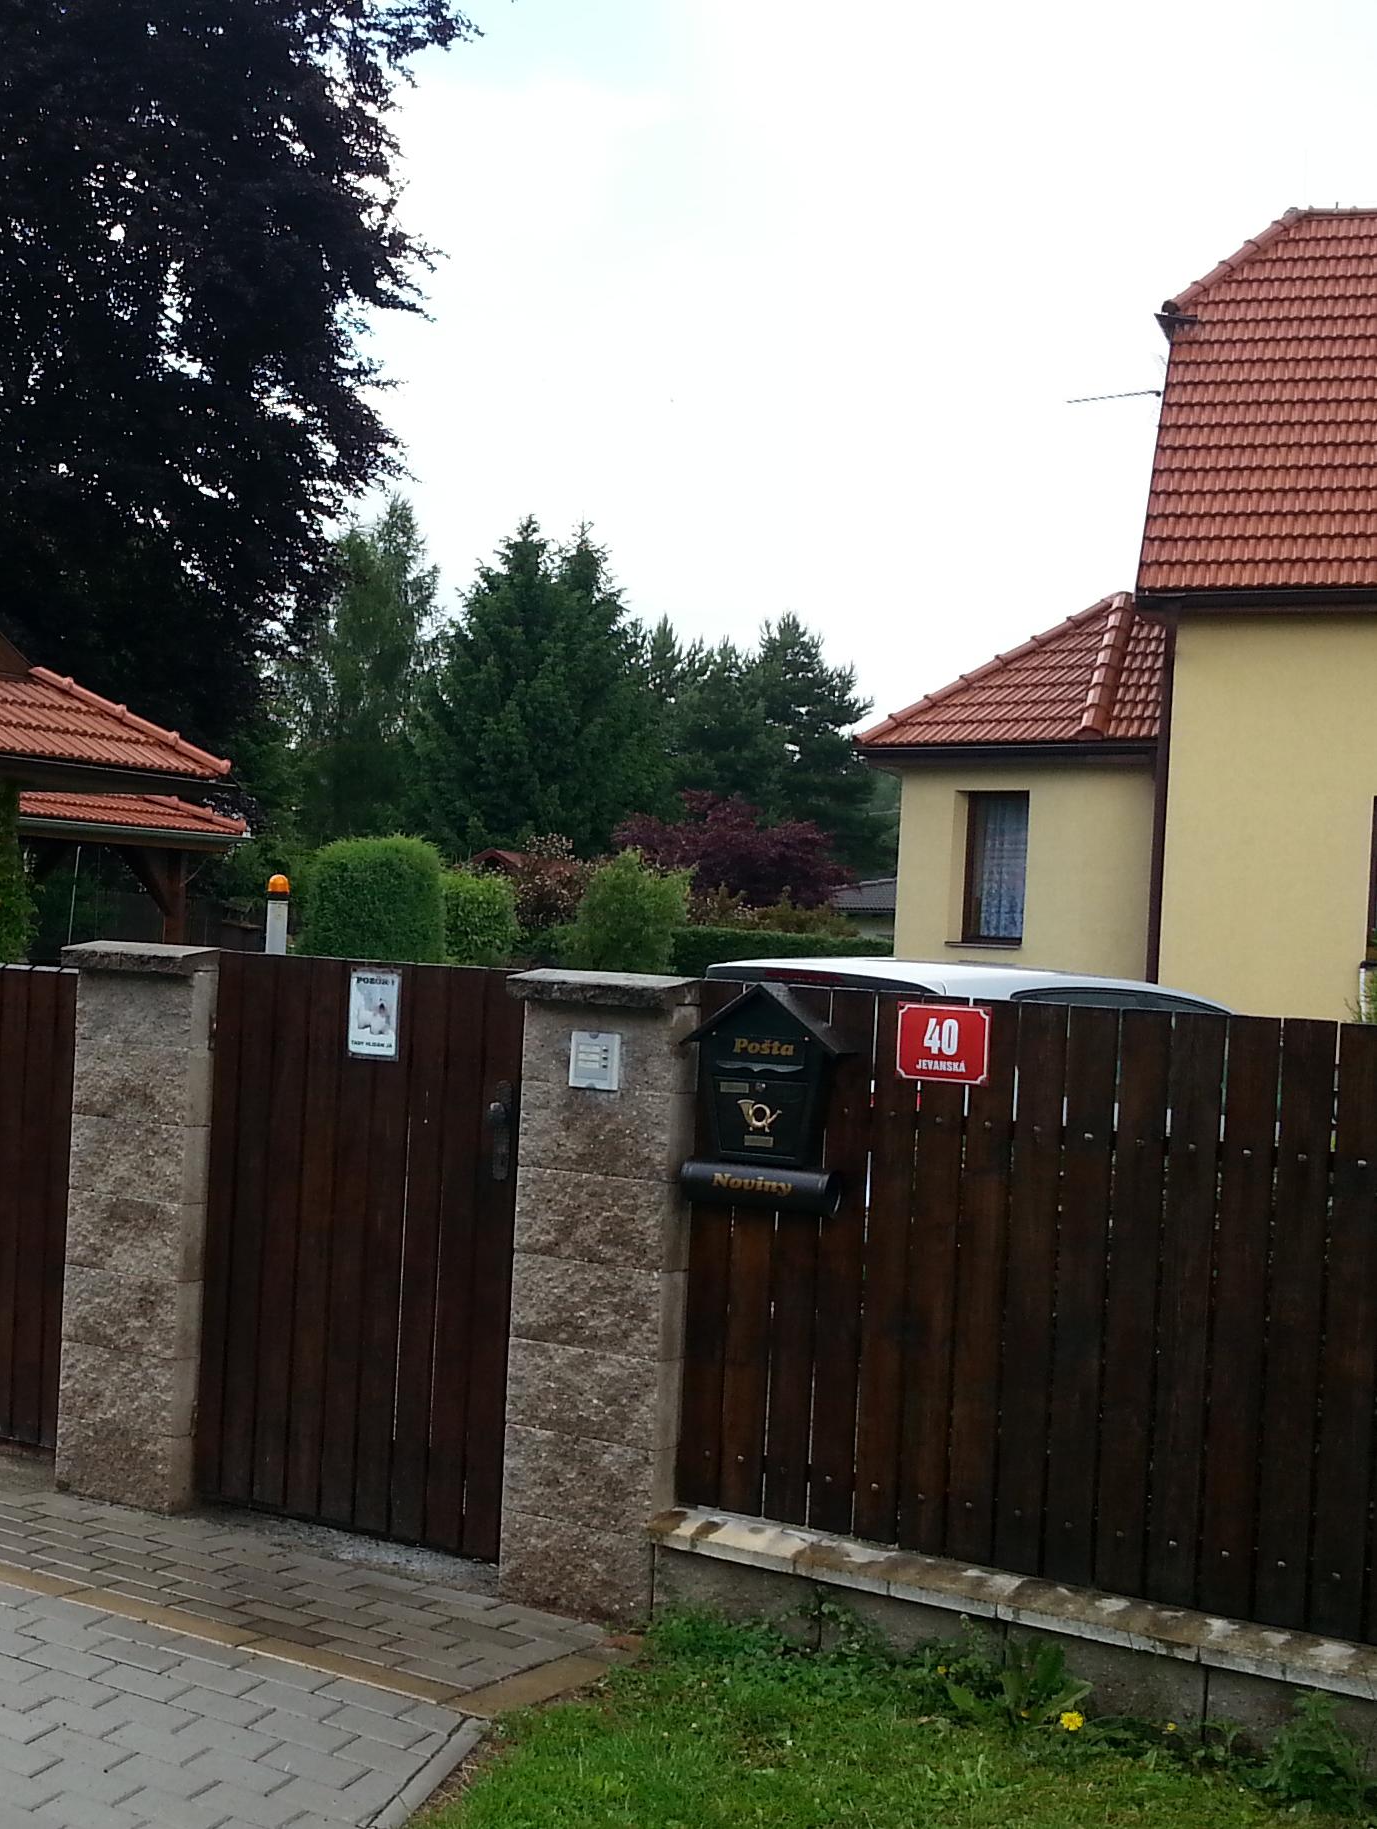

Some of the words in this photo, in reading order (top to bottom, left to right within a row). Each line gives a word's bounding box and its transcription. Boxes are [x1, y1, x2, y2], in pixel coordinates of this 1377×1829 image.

[733, 1037, 795, 1056] Pošta
[923, 1017, 959, 1056] 40
[916, 1059, 966, 1073] JEVANSKÁ
[712, 1172, 792, 1197] Noviny
